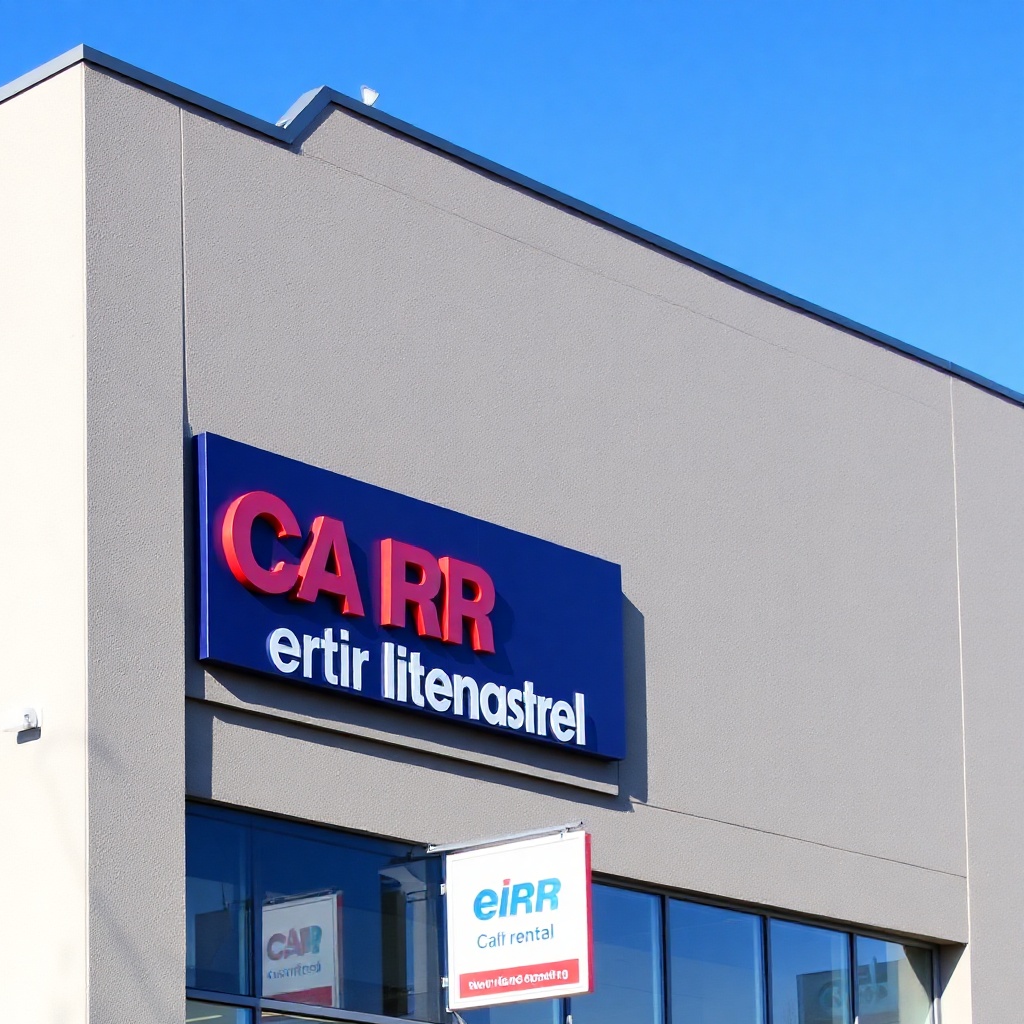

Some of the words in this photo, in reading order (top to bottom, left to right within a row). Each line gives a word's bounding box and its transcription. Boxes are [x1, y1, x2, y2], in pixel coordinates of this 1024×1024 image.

[266, 627, 369, 691] ertir
[381, 642, 586, 745] litenastrel
[510, 923, 554, 944] rental
